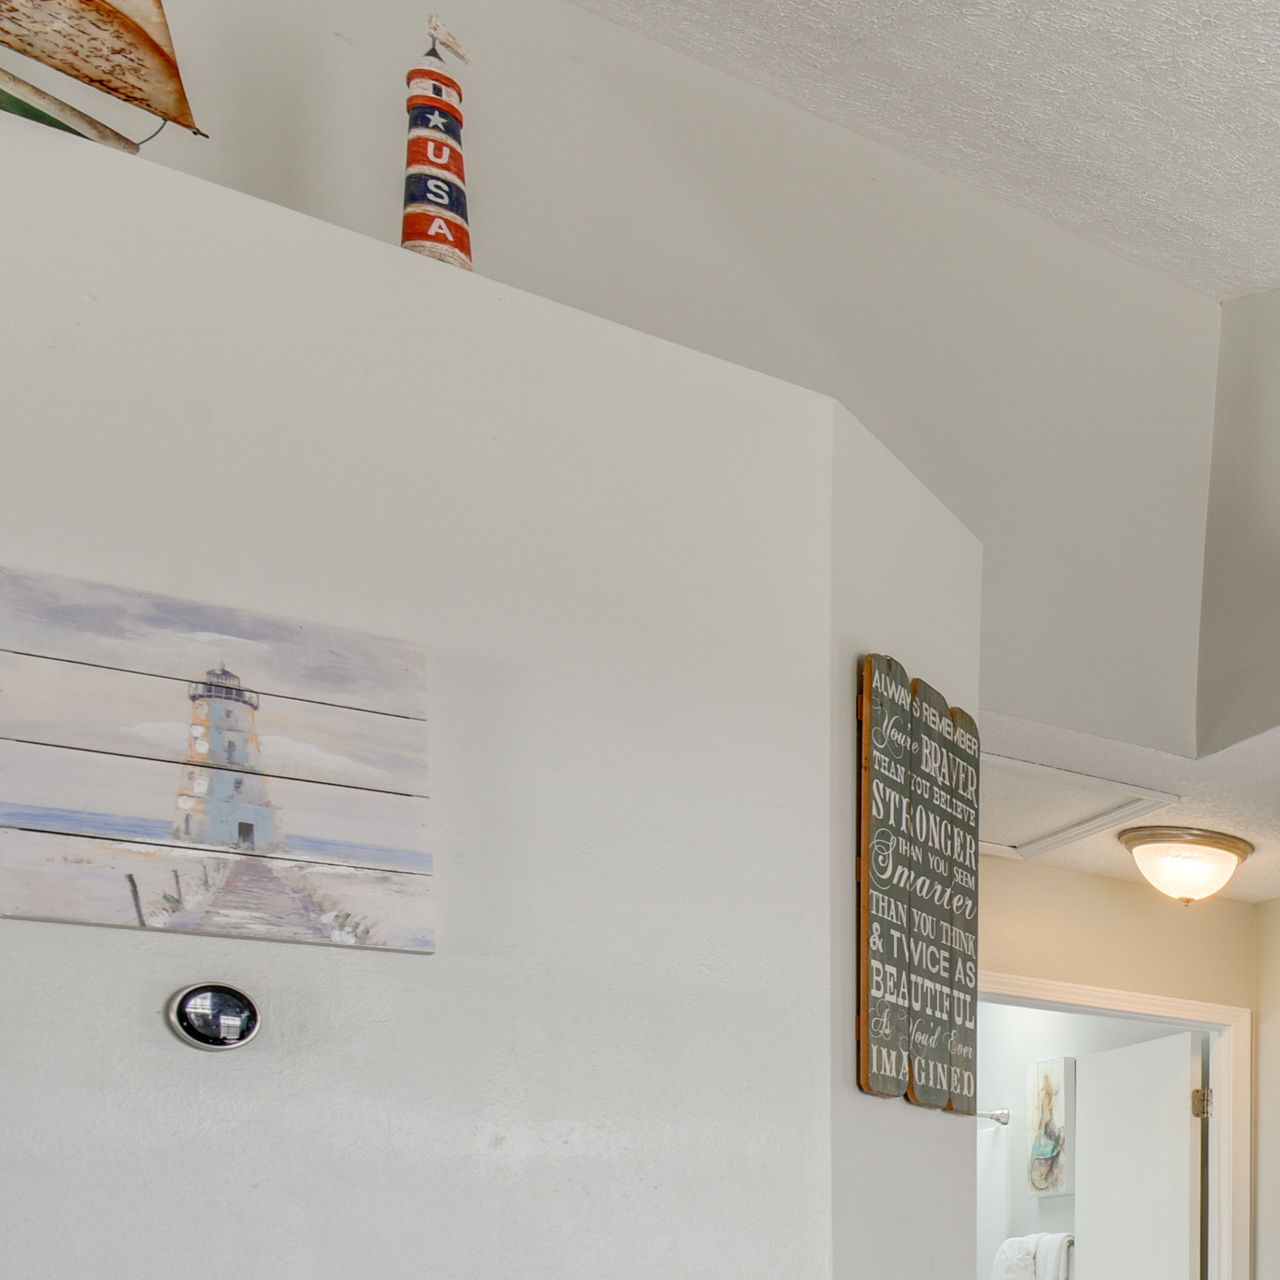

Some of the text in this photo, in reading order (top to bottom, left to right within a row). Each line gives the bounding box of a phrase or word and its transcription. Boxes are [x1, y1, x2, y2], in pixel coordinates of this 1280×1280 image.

[871, 669, 979, 759] ALWAYS REMEMBER
[871, 696, 979, 809] You're BRAVER
[872, 749, 976, 827] THAN YOU BELIEVE
[871, 778, 977, 871] STRONGER
[869, 827, 977, 920] Smarter
[897, 836, 976, 891] THAN YOU SEEM
[869, 888, 977, 960] THAN YOU THINK
[869, 921, 976, 989] & TWICE AS
[869, 958, 976, 1030] BEAUTIFUL
[869, 998, 892, 1040] As
[942, 1029, 976, 1060] Ever
[870, 1043, 976, 1098] IMAGINED
